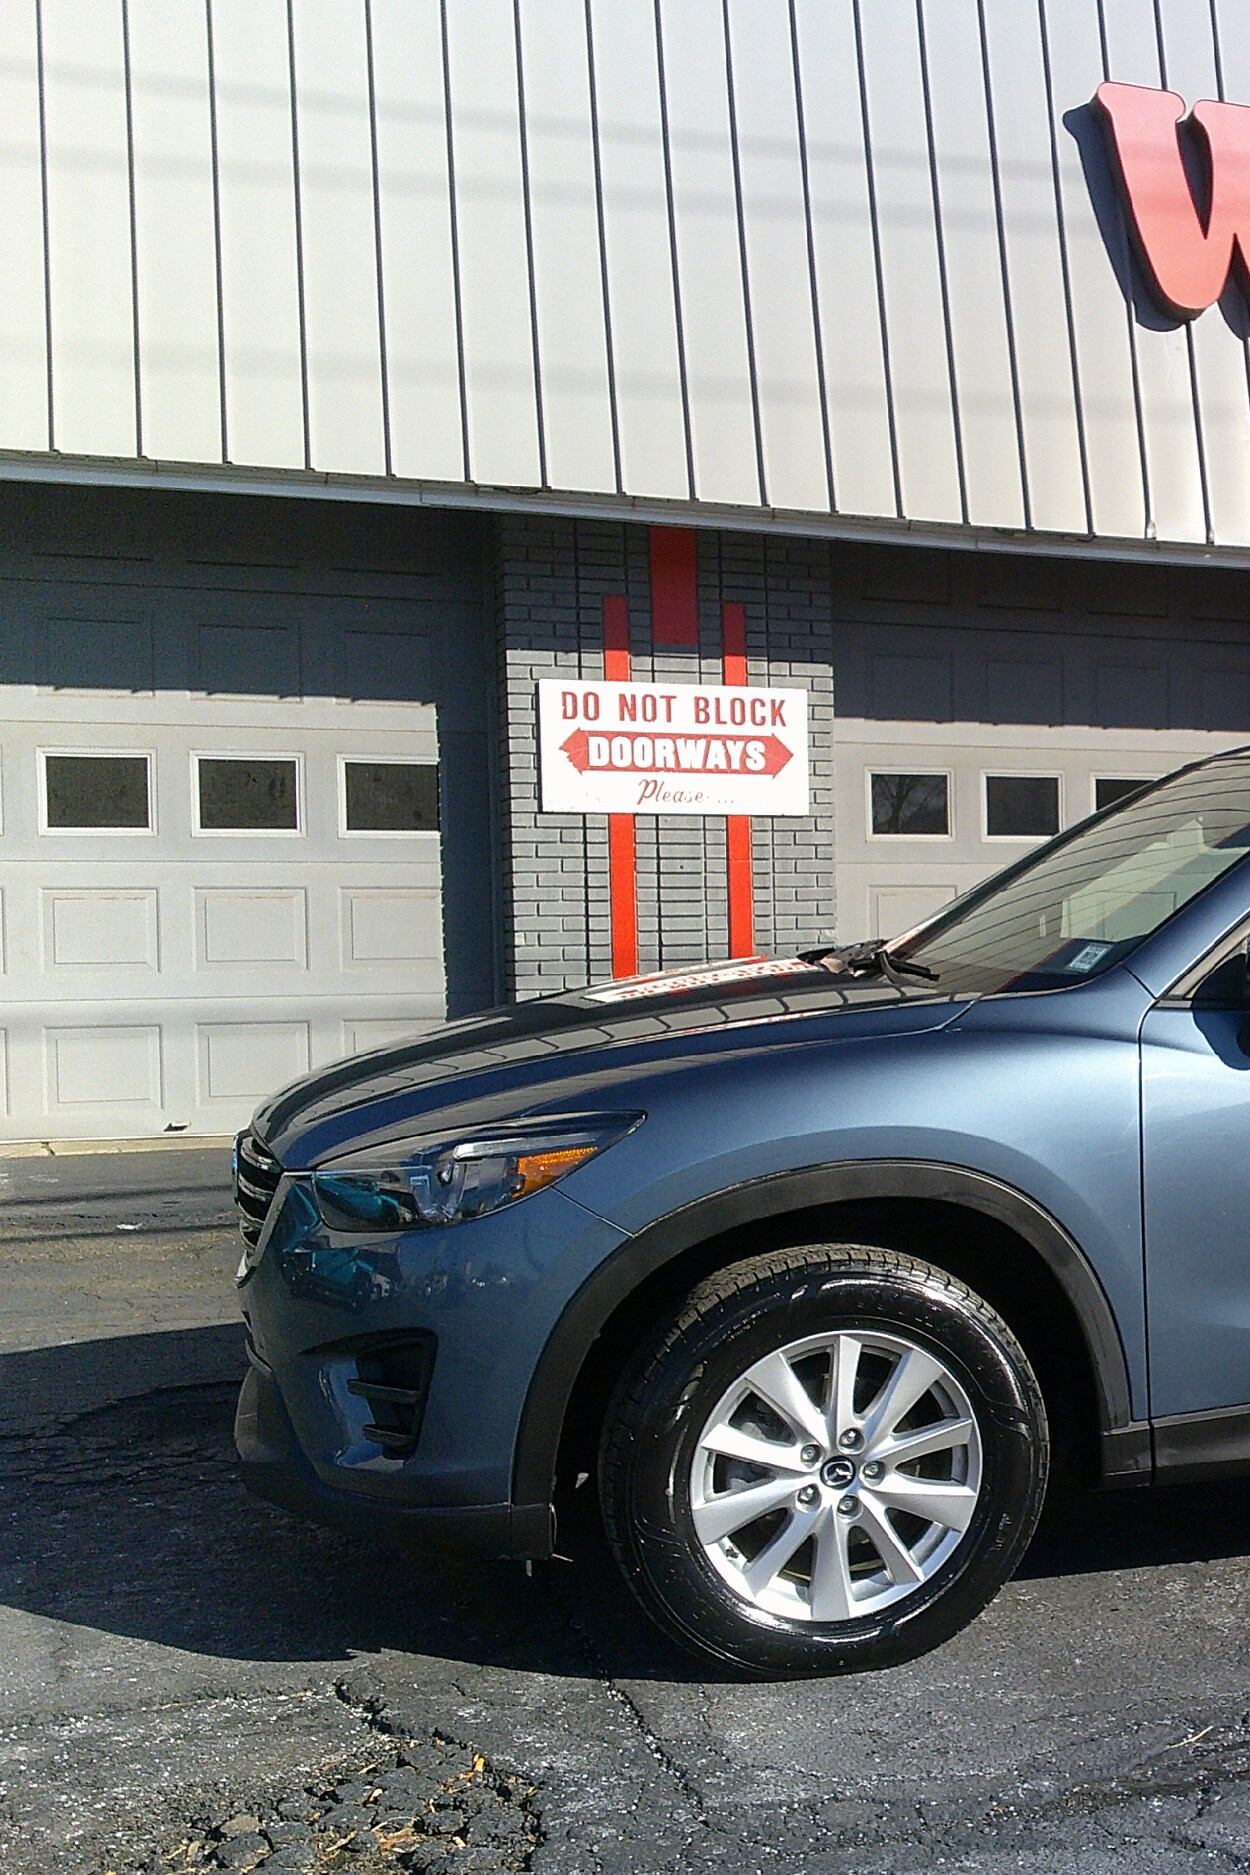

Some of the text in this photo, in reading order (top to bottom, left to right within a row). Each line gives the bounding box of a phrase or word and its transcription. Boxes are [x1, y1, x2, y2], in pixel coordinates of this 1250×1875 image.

[561, 691, 787, 727] DO NOT BLOCK
[588, 736, 767, 771] DOORWAYS
